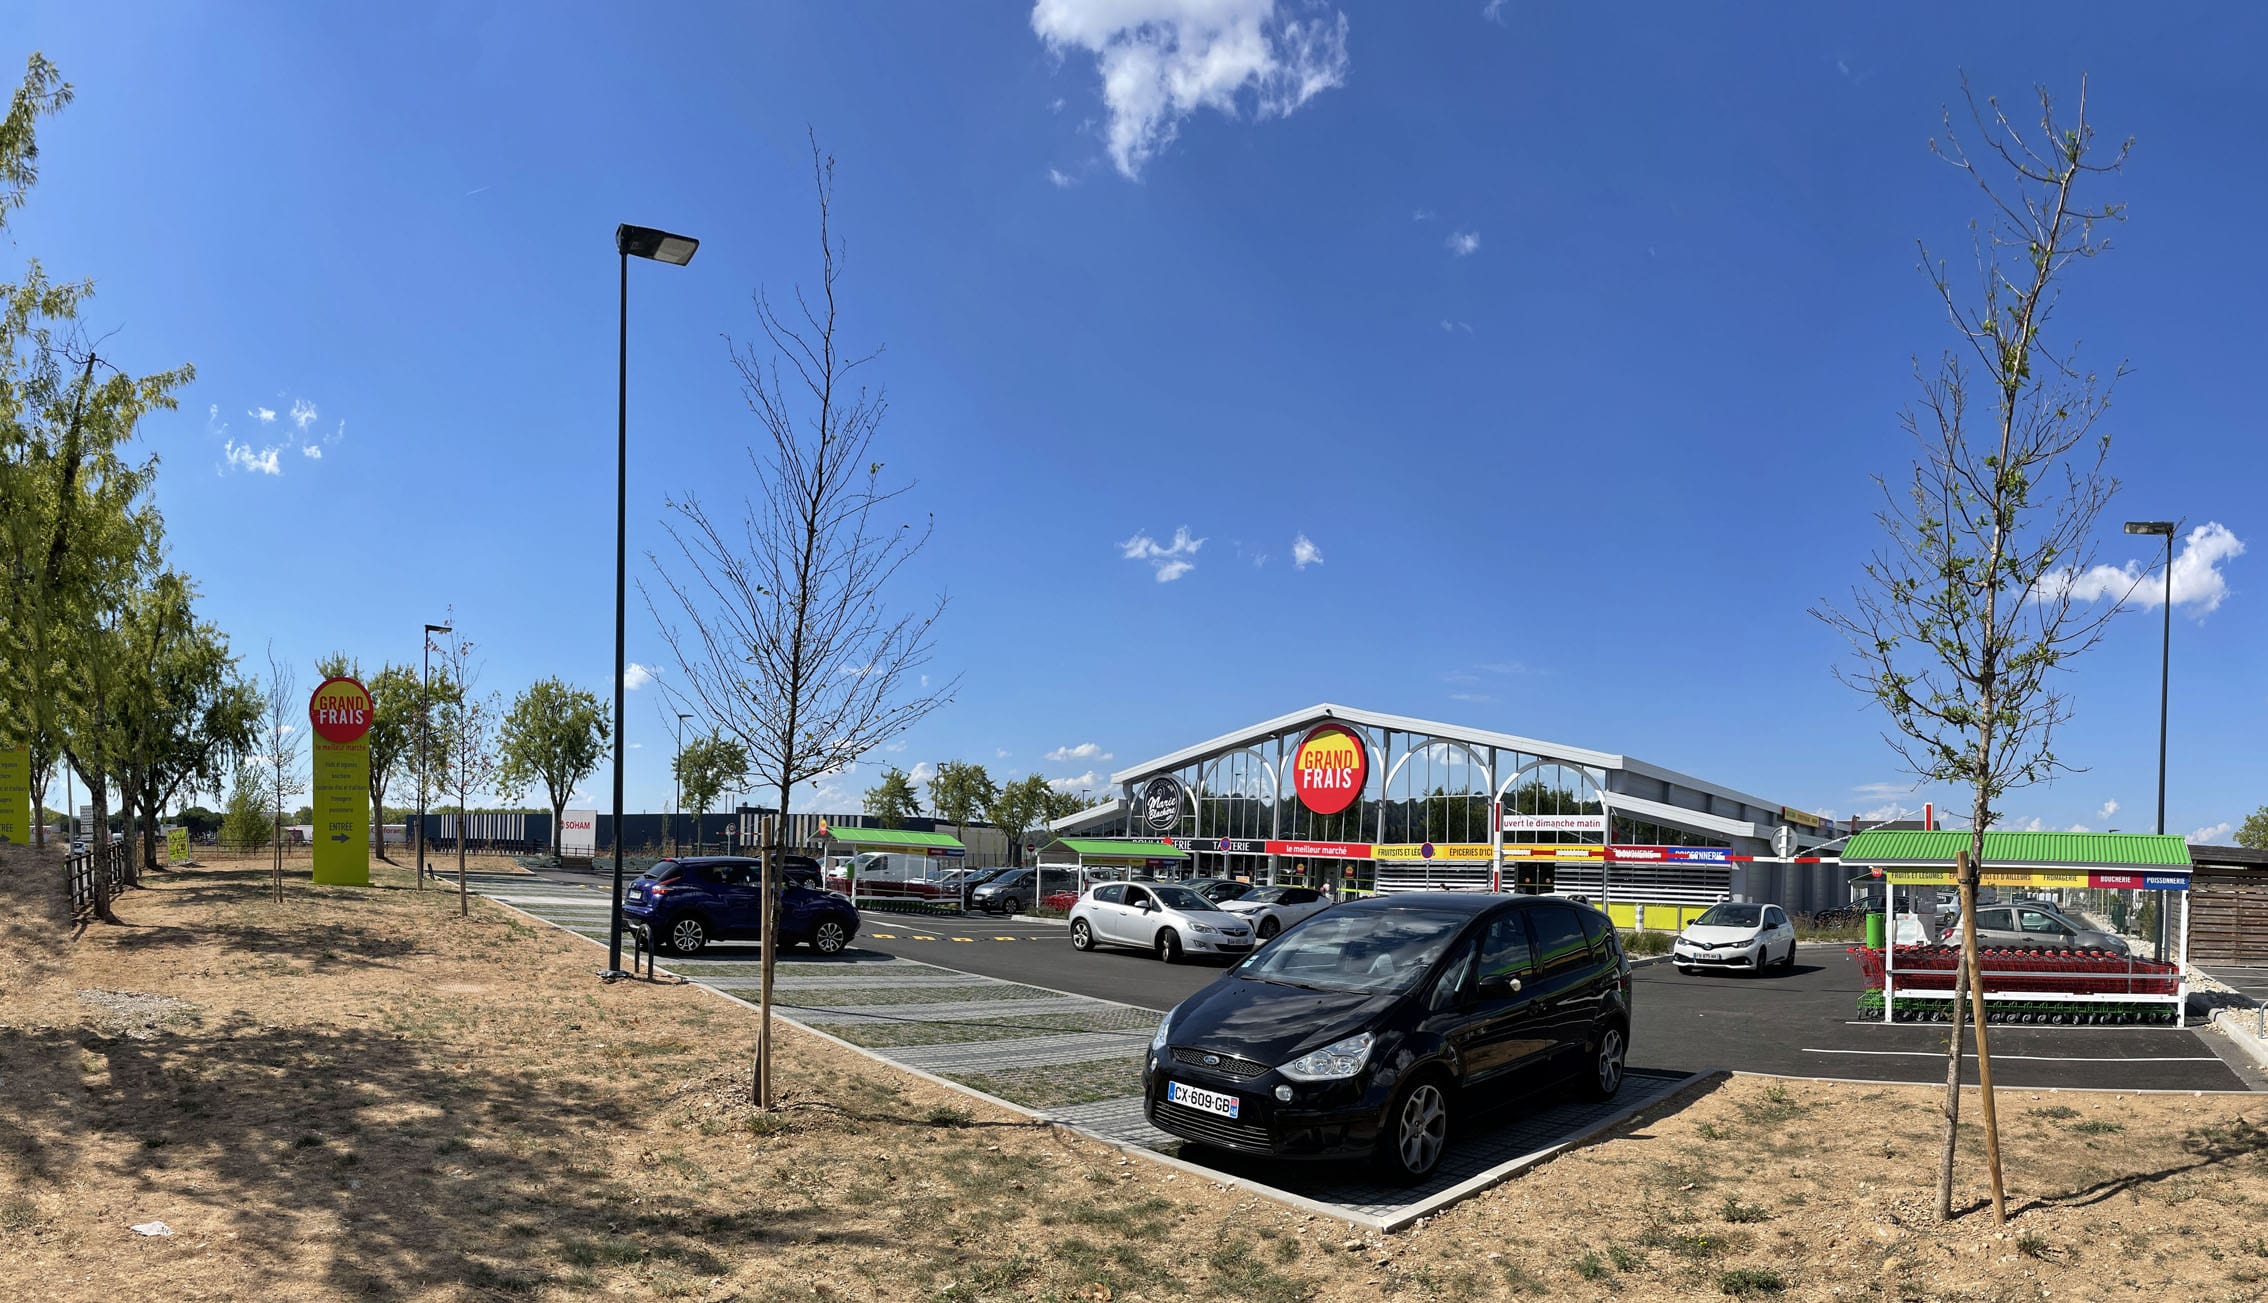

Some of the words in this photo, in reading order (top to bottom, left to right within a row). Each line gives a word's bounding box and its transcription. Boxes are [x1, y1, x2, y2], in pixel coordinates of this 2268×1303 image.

[320, 695, 364, 710] GRAND
[320, 709, 364, 725] FRAIS
[1305, 749, 1353, 769] GRAND
[1303, 767, 1352, 789] FRAIS
[1147, 796, 1177, 810] Marie
[329, 821, 353, 831] ENTRÉE
[565, 821, 591, 830] SOHAM
[1526, 819, 1534, 827] le
[1535, 819, 1575, 827] dimanche
[1577, 819, 1601, 828] matin
[1212, 841, 1250, 851] TATERIE
[1286, 844, 1293, 852] le
[1293, 845, 1320, 854] meilleur
[1321, 846, 1347, 855] marché
[1404, 848, 1410, 856] ET
[1449, 847, 1478, 857] ÉPICERIES
[1479, 847, 1493, 857] D'ICI
[2043, 873, 2078, 881] FROMAGERIE
[2100, 875, 2132, 883] BOUCHERIE
[2146, 877, 2186, 885] POISSONNERIE
[1175, 1086, 1230, 1112] CX-609-GB
